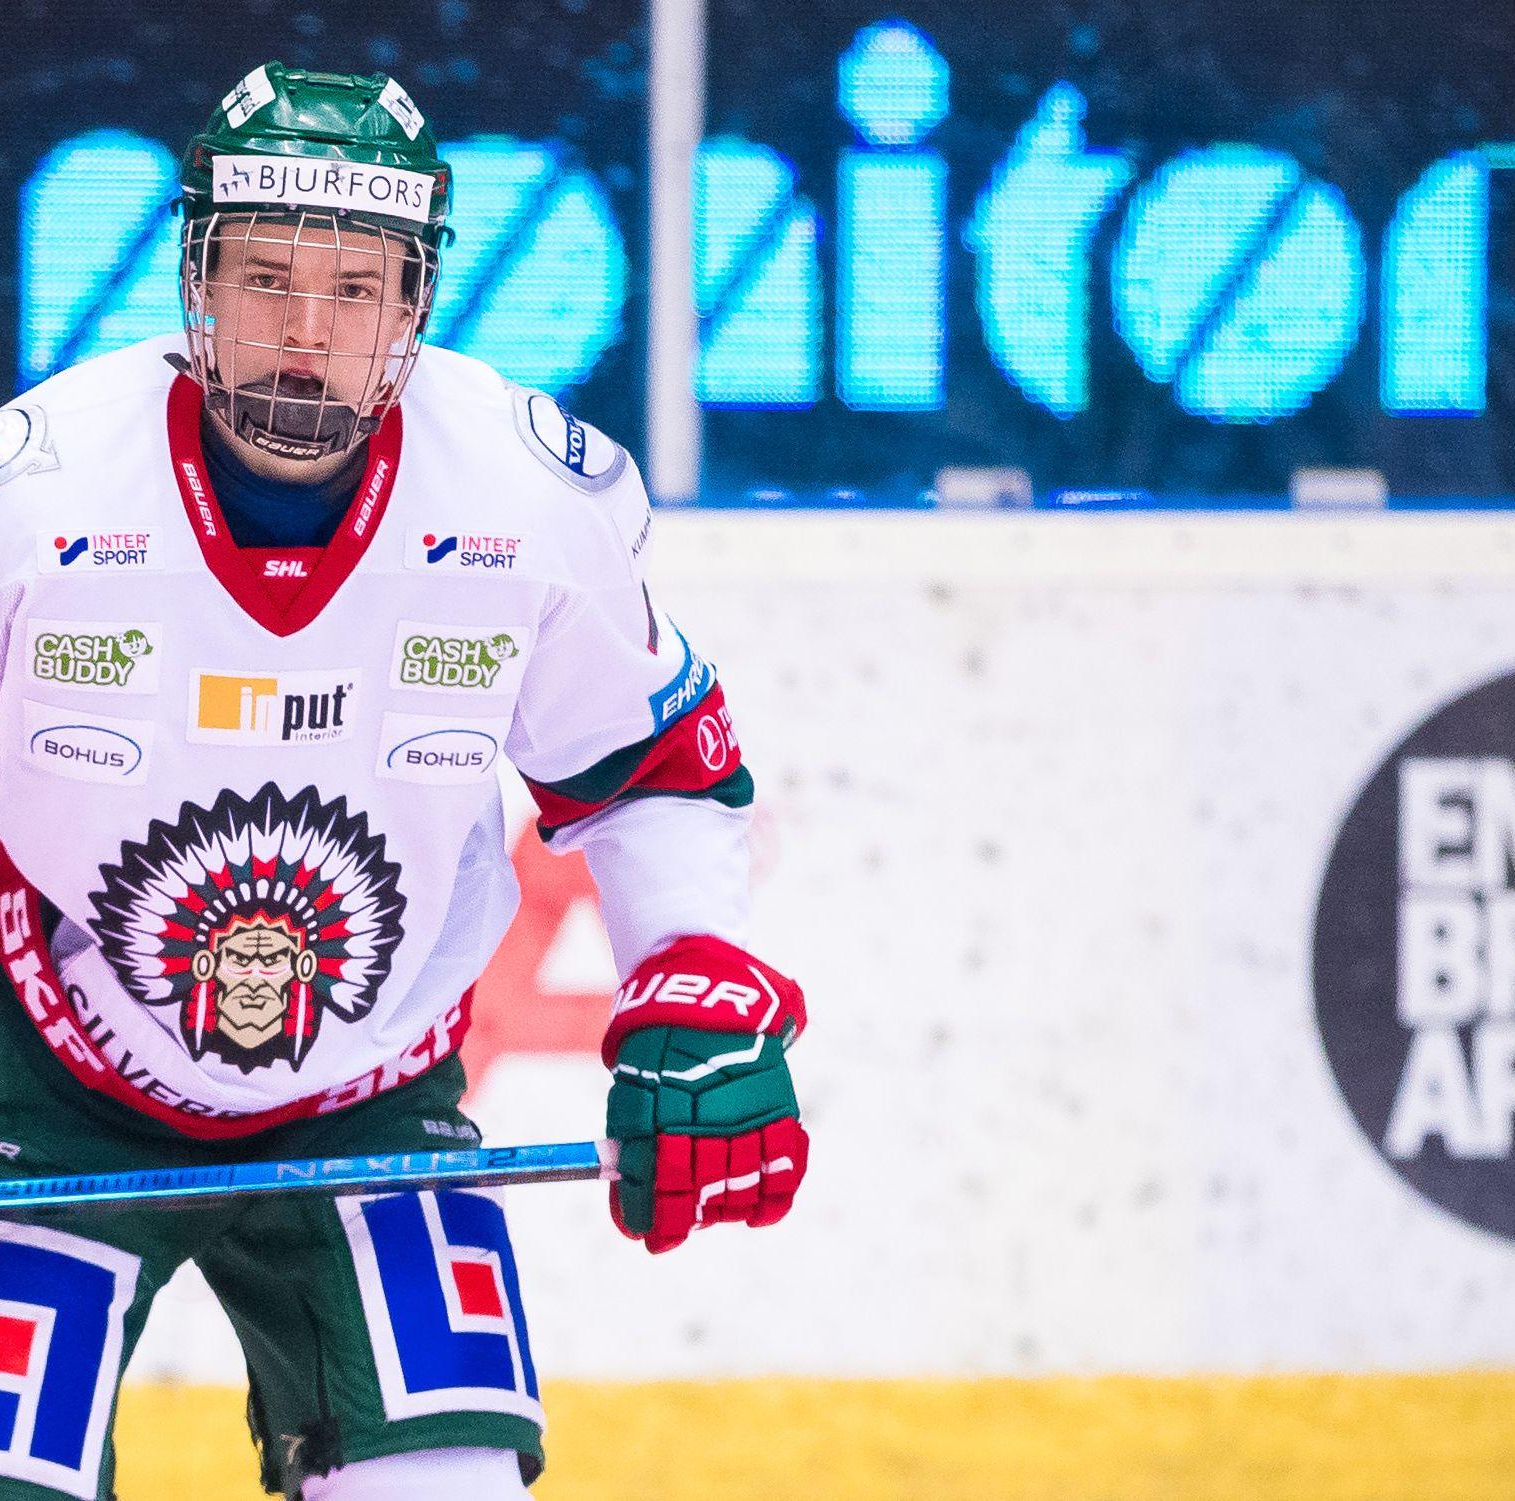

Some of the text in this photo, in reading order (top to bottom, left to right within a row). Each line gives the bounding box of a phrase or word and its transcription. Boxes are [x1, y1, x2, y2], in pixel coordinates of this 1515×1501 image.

[259, 165, 423, 208] BJURFORS
[182, 462, 217, 536] BAUER
[353, 460, 389, 537] BAUER
[92, 534, 147, 549] INTER
[462, 535, 516, 553] INTER
[93, 550, 147, 565] SPORT
[263, 559, 308, 578] SHL
[460, 552, 516, 569] SPORT
[36, 633, 115, 661] CASH
[404, 635, 483, 663] CASH
[35, 656, 136, 686] BUDDY
[401, 658, 501, 688] BUDDY
[45, 739, 125, 767] BOHUS
[406, 750, 483, 766] BOHUS
